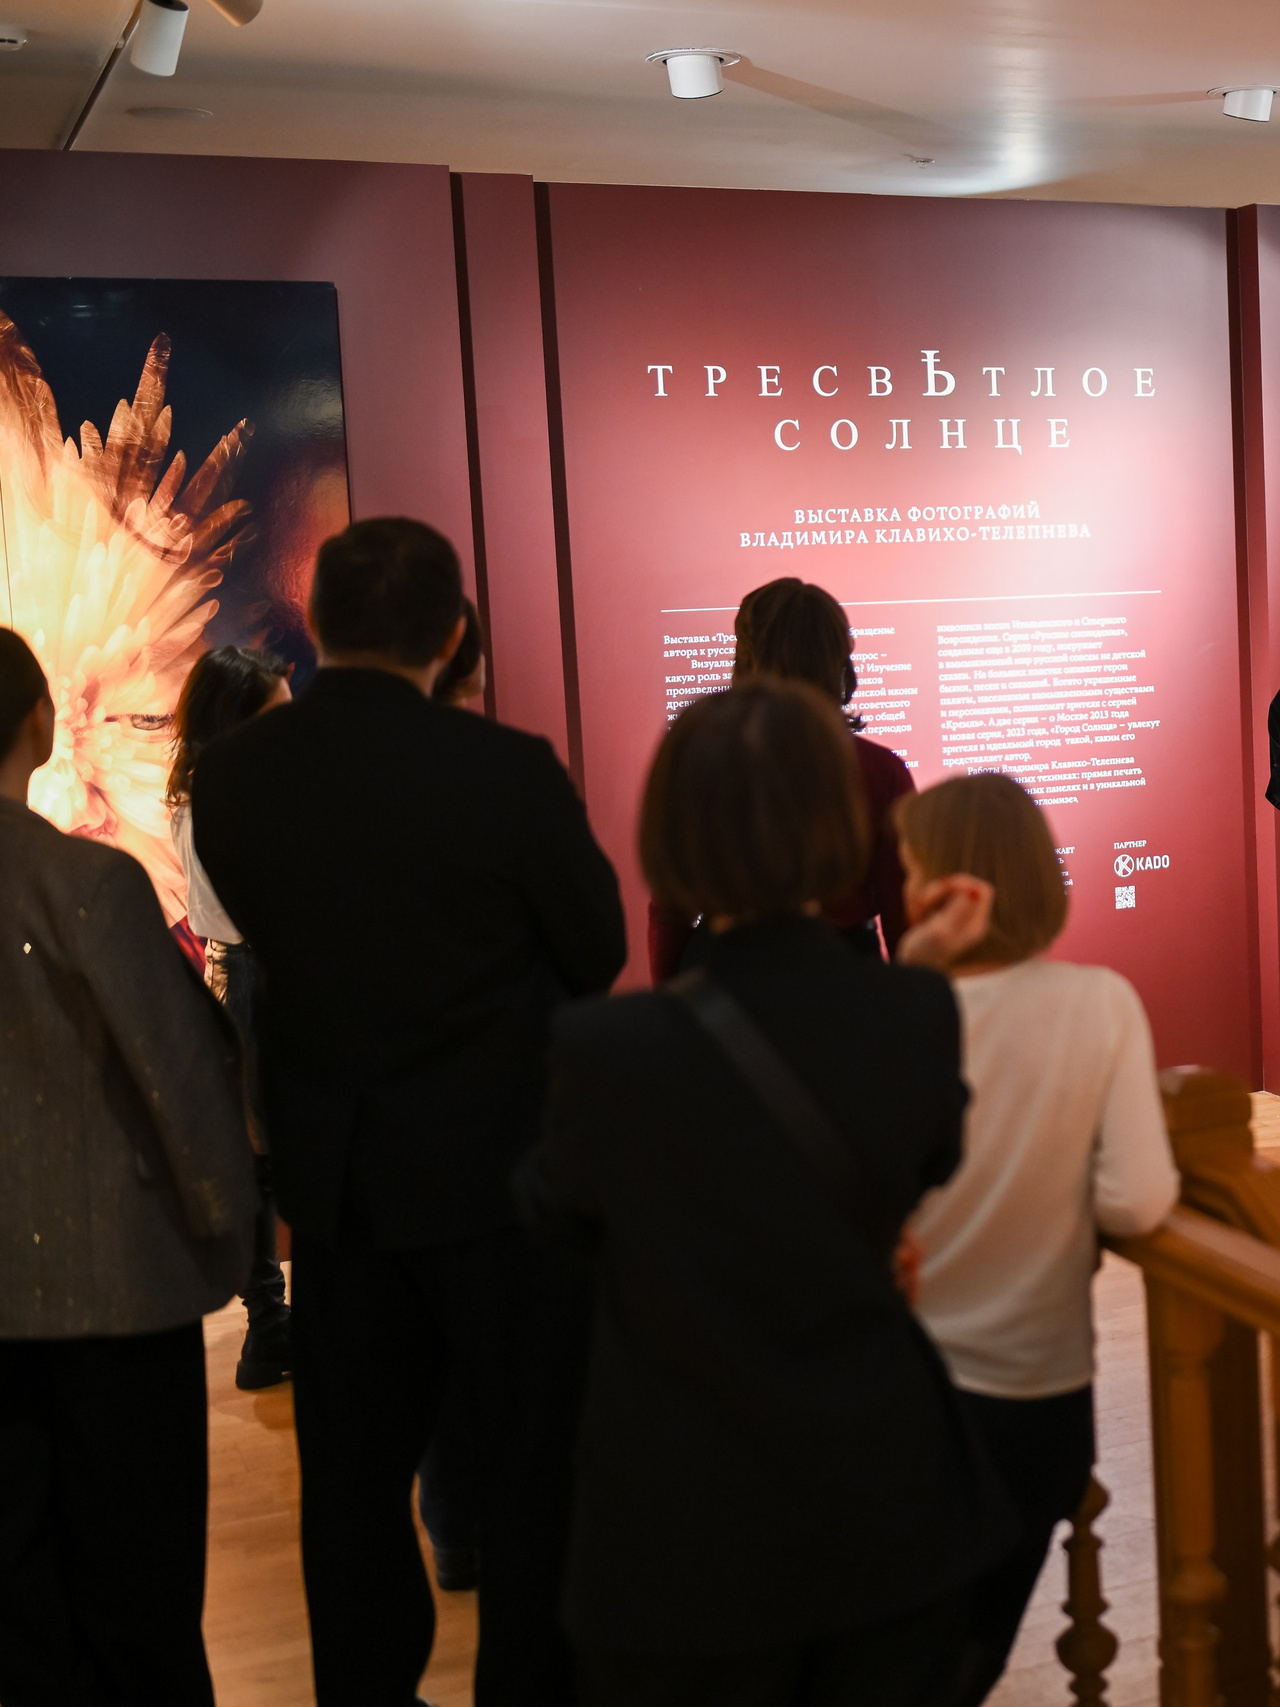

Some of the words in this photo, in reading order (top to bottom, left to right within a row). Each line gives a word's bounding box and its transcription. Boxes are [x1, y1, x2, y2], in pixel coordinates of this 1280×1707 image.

[774, 418, 1071, 455] СОЛНЦЕ
[794, 507, 902, 524] ВЫСТАВКА
[907, 501, 1041, 522] ФОТОГРАФИЙ
[740, 529, 869, 549] ВЛАДИМИРА
[875, 523, 1092, 544] КЛАВИХО-ТЕЛЕПНЕВА
[663, 635, 710, 645] Выставка
[849, 627, 896, 639] бращение
[1001, 631, 1029, 644] Серия
[663, 648, 698, 659] автора
[700, 648, 706, 656] к
[707, 646, 737, 658] русск
[1033, 652, 1068, 667] русской
[1100, 653, 1111, 662] не
[1111, 649, 1146, 662] детской
[691, 659, 736, 670] Визуальн
[849, 652, 879, 663] опрос
[665, 675, 696, 684] какую
[697, 673, 721, 684] роль
[866, 663, 912, 674] Изучение
[973, 669, 987, 680] На
[1103, 664, 1128, 675] герои
[856, 677, 884, 686] ников
[1082, 675, 1136, 688] украшенные
[887, 687, 919, 696] иконы
[1103, 686, 1154, 698] существами
[858, 700, 911, 710] советского
[1066, 700, 1100, 712] зрителя
[1107, 696, 1137, 710] серией
[875, 711, 907, 722] общей
[1012, 716, 1039, 727] серии
[1056, 712, 1088, 723] Москве
[1089, 709, 1109, 721] 2013
[1110, 711, 1129, 721] года
[867, 724, 912, 736] периодов
[949, 732, 975, 741] новая
[976, 730, 1004, 741] серия,
[1006, 726, 1025, 738] 2023
[1026, 727, 1049, 737] года,
[1050, 724, 1081, 736] «Город
[1081, 722, 1117, 733] Солнца»
[1127, 720, 1160, 733] увлекут
[942, 743, 978, 756] зрителя
[986, 737, 1034, 752] идеальный
[1035, 738, 1061, 749] город
[1064, 734, 1093, 746] такой,
[1094, 734, 1120, 744] каким
[1120, 733, 1135, 742] его
[942, 755, 1003, 768] представляет
[1003, 753, 1031, 764] автор.
[1001, 762, 1049, 774] Владимира
[1051, 757, 1134, 771] Клавихо-Телепнева
[1013, 775, 1036, 785] зных
[1037, 772, 1079, 783] техниках:
[1081, 770, 1112, 782] прямая
[1113, 768, 1142, 778] печать
[1045, 784, 1081, 795] панелях
[1095, 776, 1146, 793] уникальной
[1113, 840, 1147, 850] ПАРТНЕР
[1136, 855, 1170, 871] KADO
